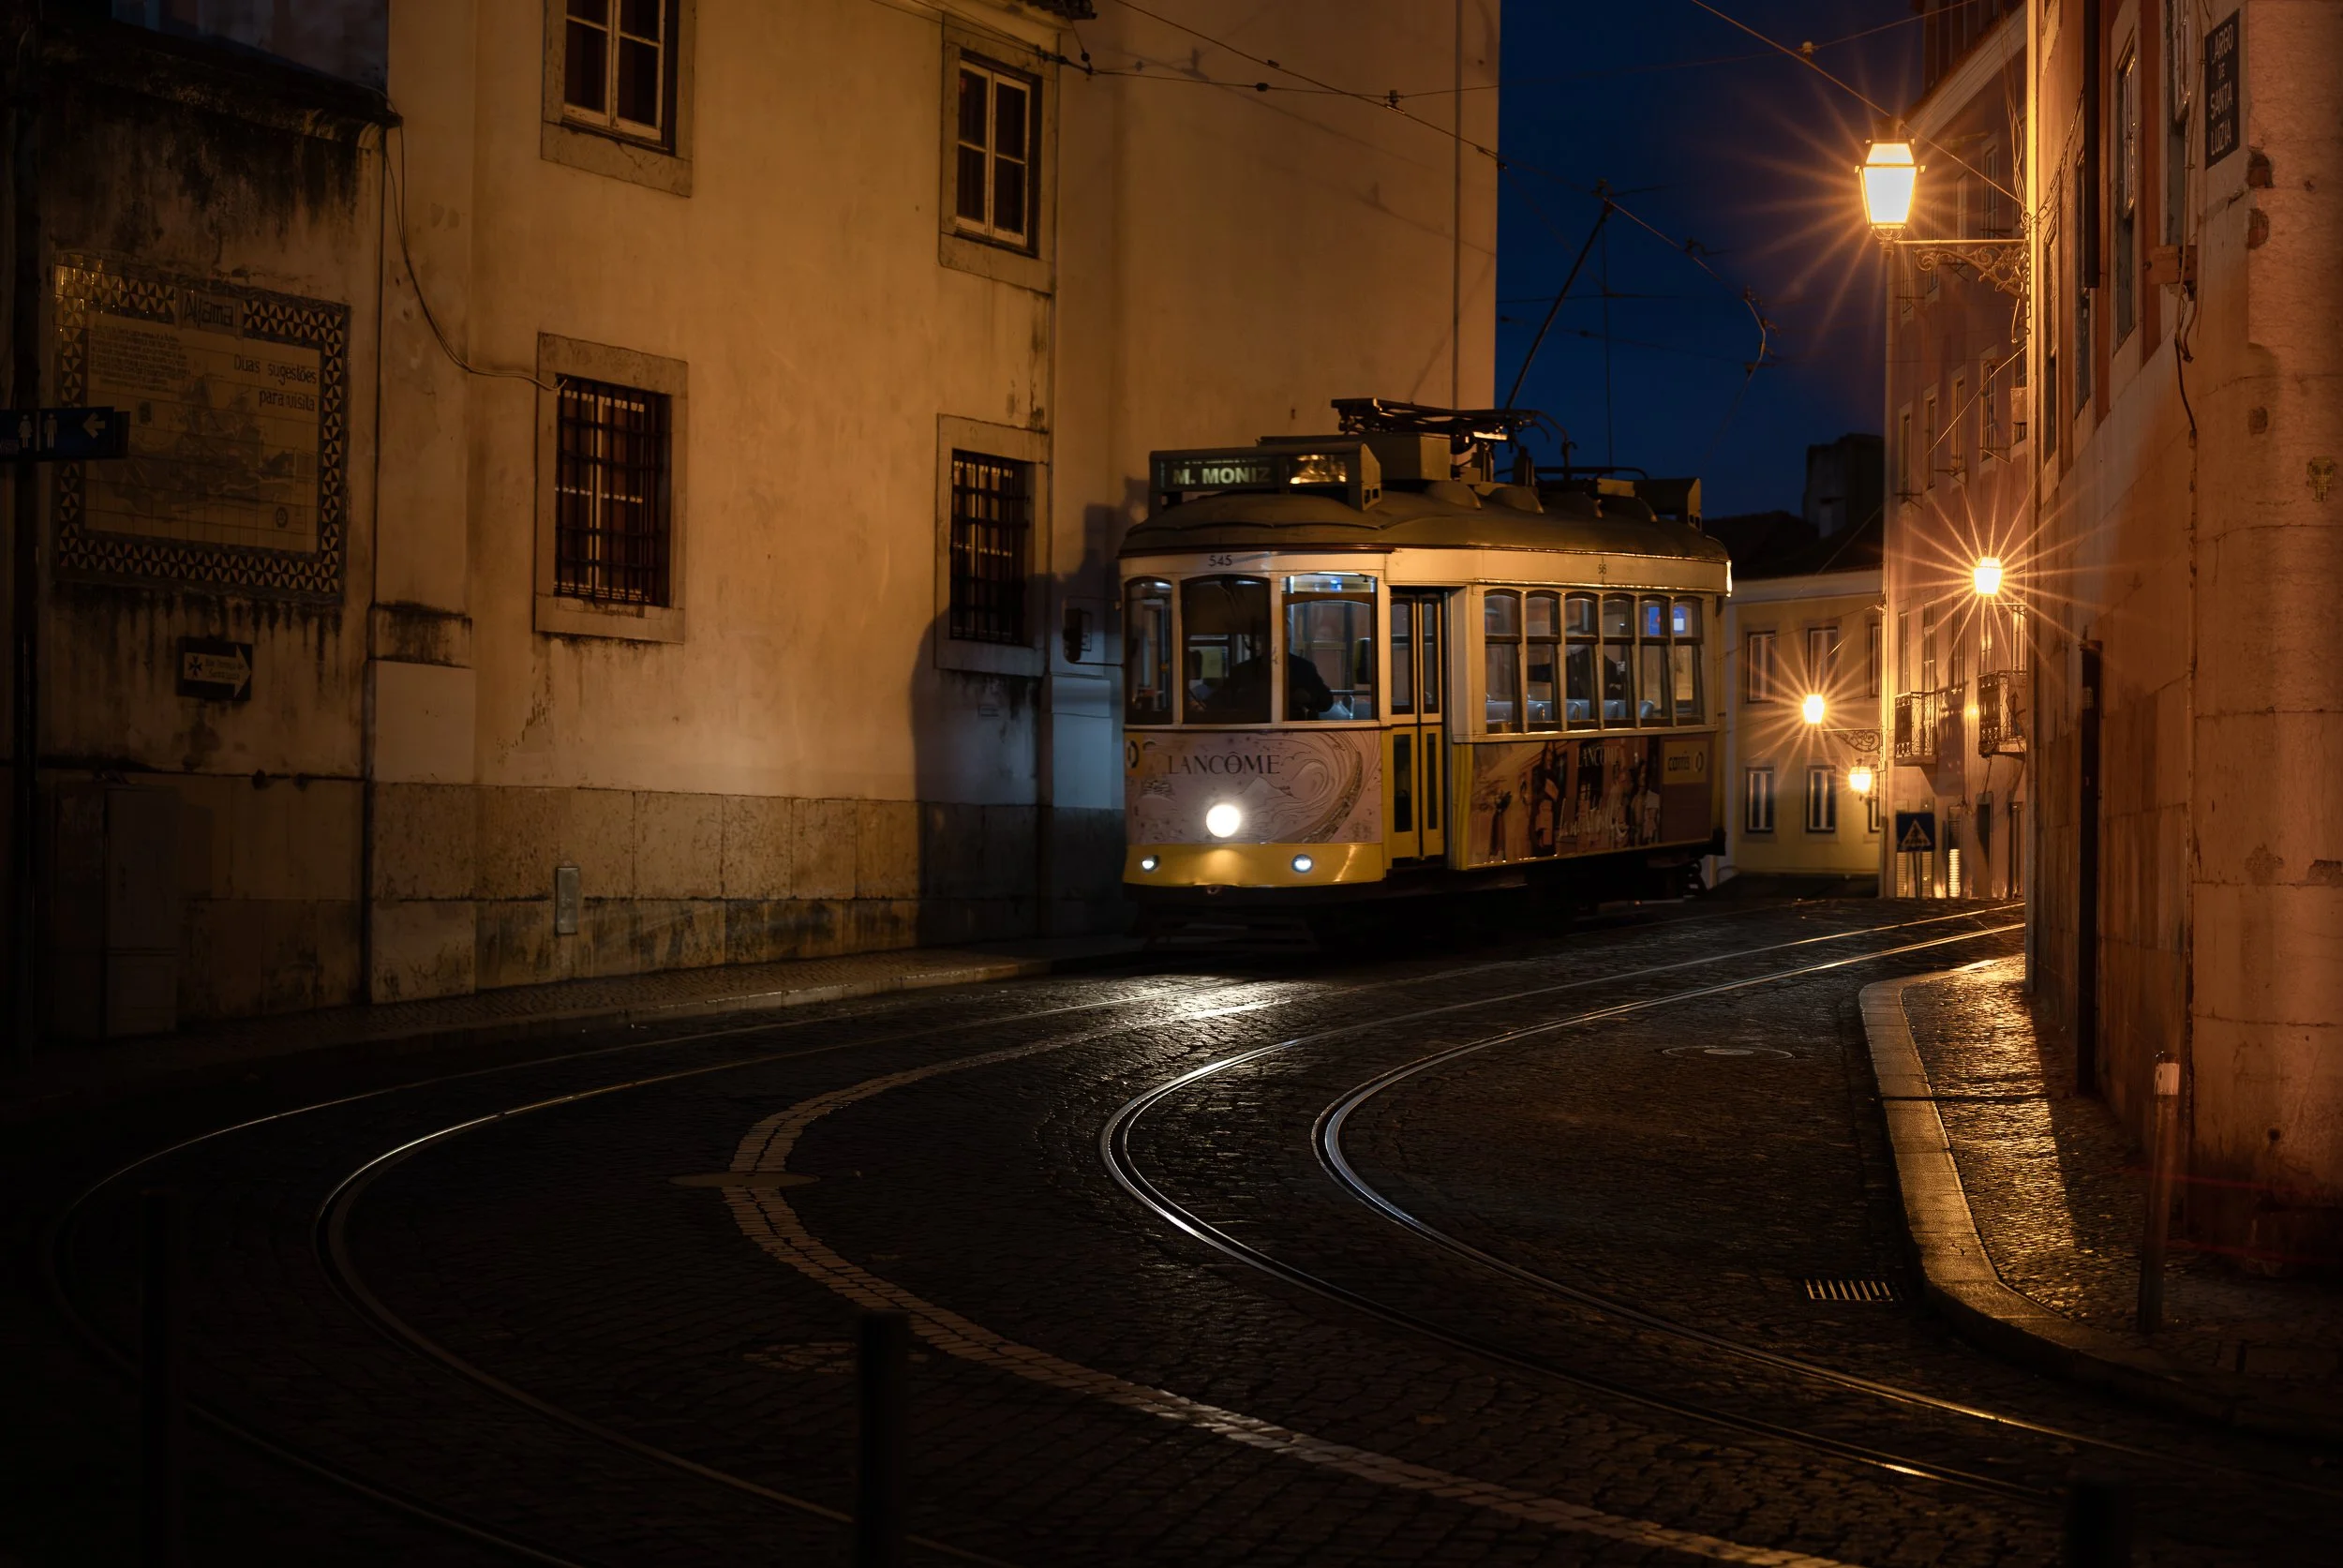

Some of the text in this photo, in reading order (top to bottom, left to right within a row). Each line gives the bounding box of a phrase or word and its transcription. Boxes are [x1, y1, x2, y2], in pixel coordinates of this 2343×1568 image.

[2209, 23, 2233, 65] LARGO
[2217, 62, 2226, 80] DE
[2210, 80, 2233, 120] SANTA
[2210, 118, 2232, 157] LUZIA
[233, 353, 317, 386] Duas sugestões
[259, 390, 316, 411] para visita
[1172, 467, 1271, 485] M. MONIZ
[1208, 555, 1233, 567] 545
[1167, 751, 1282, 775] LANCÔME
